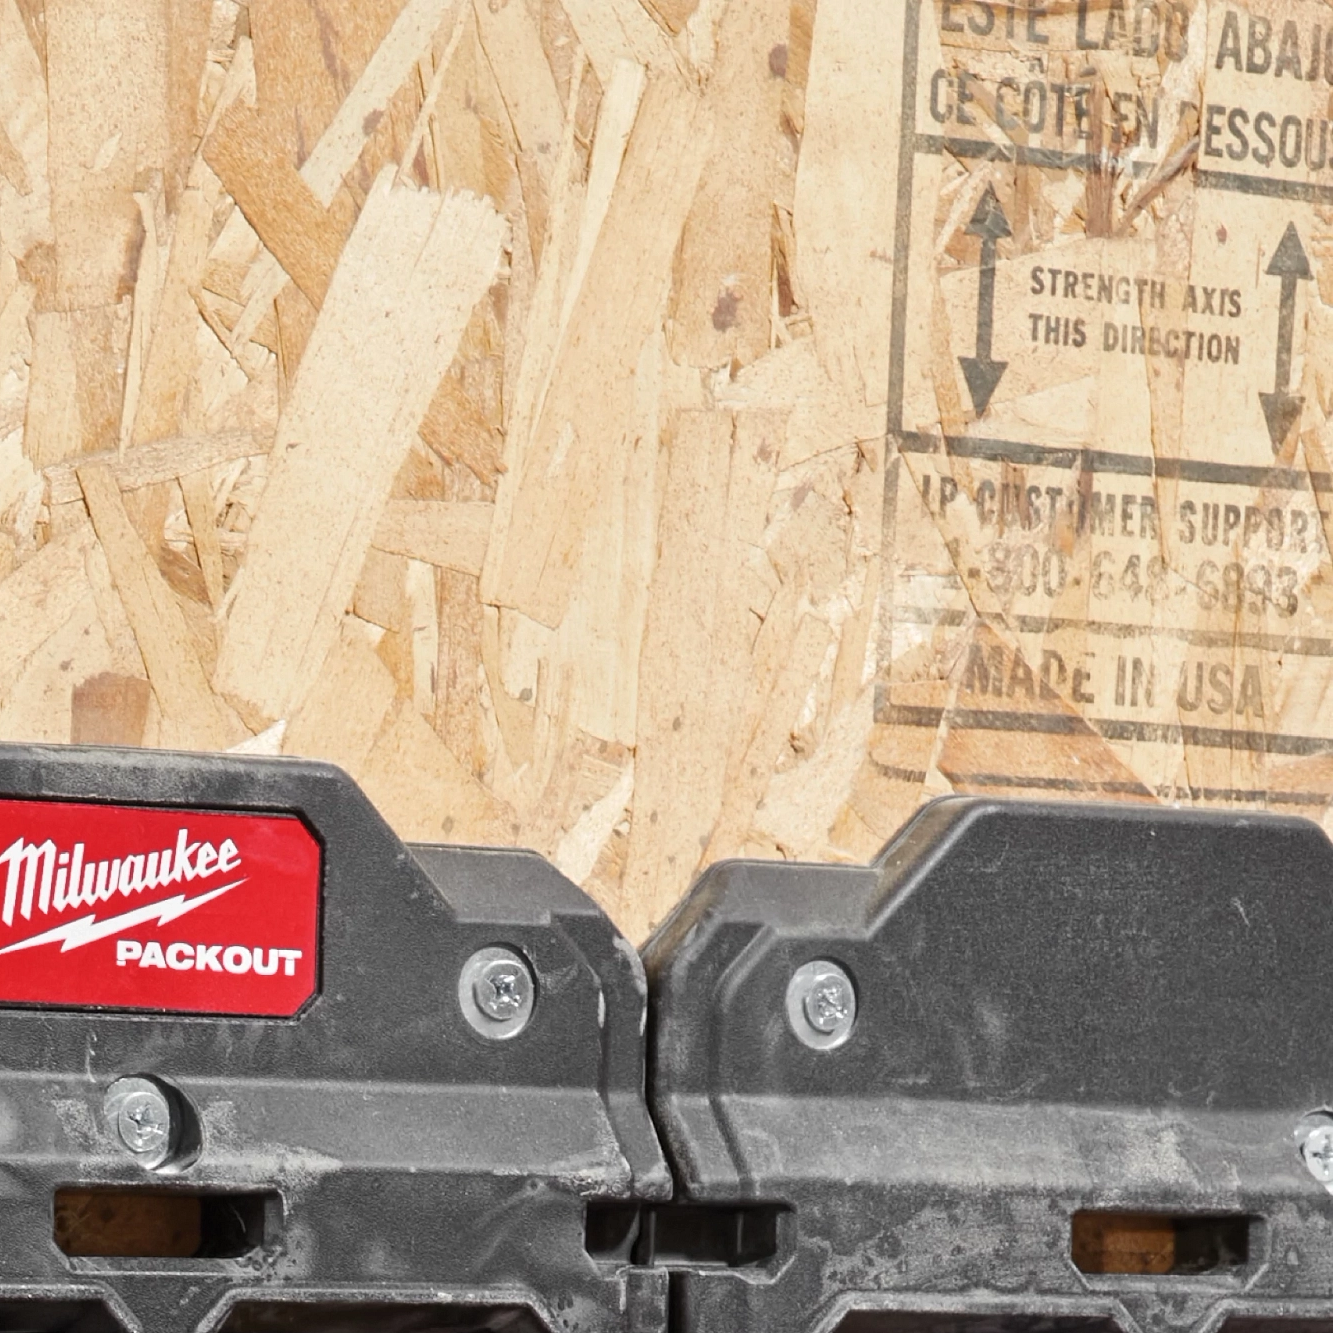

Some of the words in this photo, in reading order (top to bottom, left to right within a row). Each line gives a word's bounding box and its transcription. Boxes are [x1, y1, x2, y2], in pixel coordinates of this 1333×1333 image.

[1031, 266, 1165, 309] STRENGTH
[1186, 284, 1242, 318] AXIS
[1029, 312, 1087, 347] THIS
[1103, 322, 1240, 366] DIRECTION
[1115, 654, 1154, 708] IN
[1176, 659, 1264, 718] USA
[116, 940, 302, 976] PACKOUT
